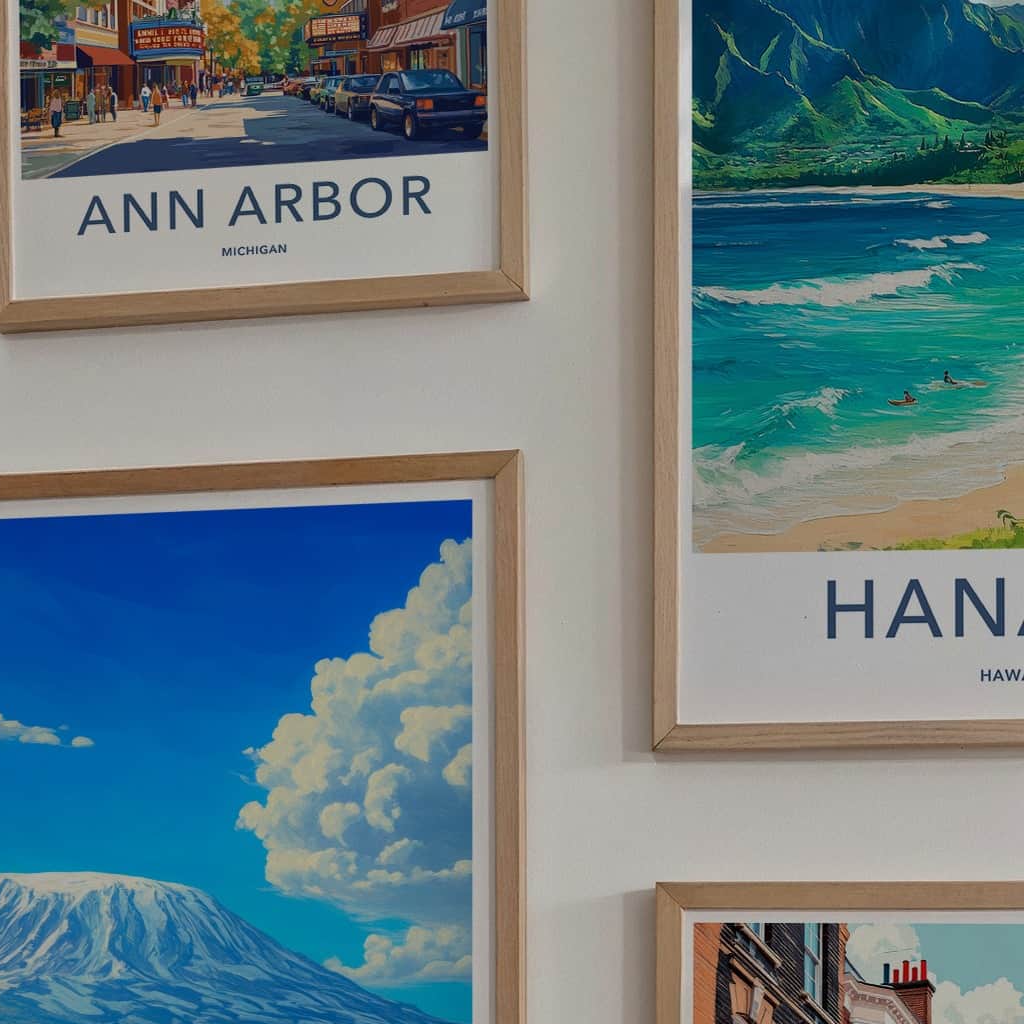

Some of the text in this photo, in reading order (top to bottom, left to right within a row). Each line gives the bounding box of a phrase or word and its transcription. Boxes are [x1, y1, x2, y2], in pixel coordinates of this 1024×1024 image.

[77, 175, 432, 236] ANN ARBOR
[221, 243, 288, 257] MICHIGAN
[827, 577, 1024, 639] HAN
